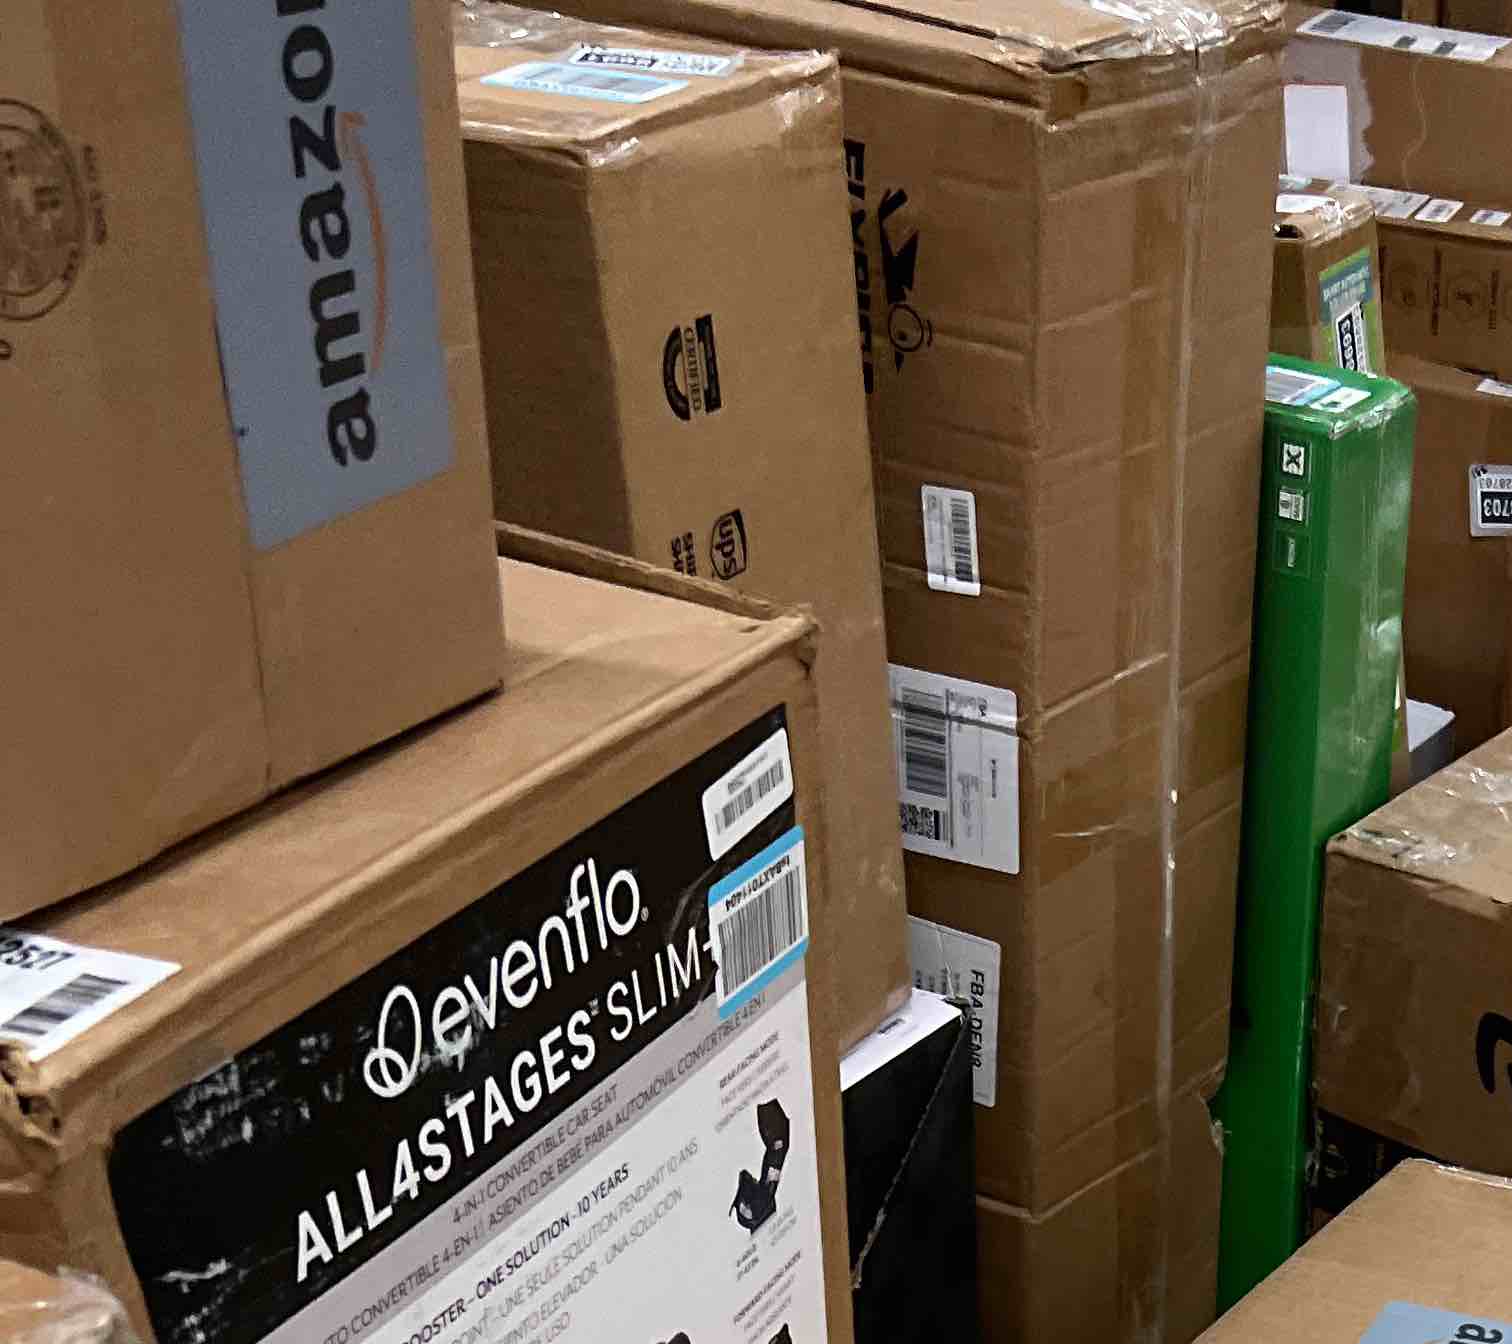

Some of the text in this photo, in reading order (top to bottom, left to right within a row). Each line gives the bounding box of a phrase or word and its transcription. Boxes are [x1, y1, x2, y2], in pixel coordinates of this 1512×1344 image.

[275, 0, 380, 467] amazo
[718, 518, 738, 575] ups
[433, 858, 641, 1057] evenflo
[969, 969, 986, 1009] FBA
[485, 1124, 565, 1200] CONVERTIBLE
[566, 1105, 588, 1137] CAR
[588, 1082, 618, 1119] SEAT
[350, 1250, 440, 1338] CONVERTIBLE
[539, 1162, 554, 1188] DE
[584, 1115, 612, 1152] PARA
[475, 1263, 504, 1301] ONE
[505, 1210, 570, 1276] SOLUTION
[577, 1193, 590, 1218] 10
[591, 1161, 629, 1206] YEARS
